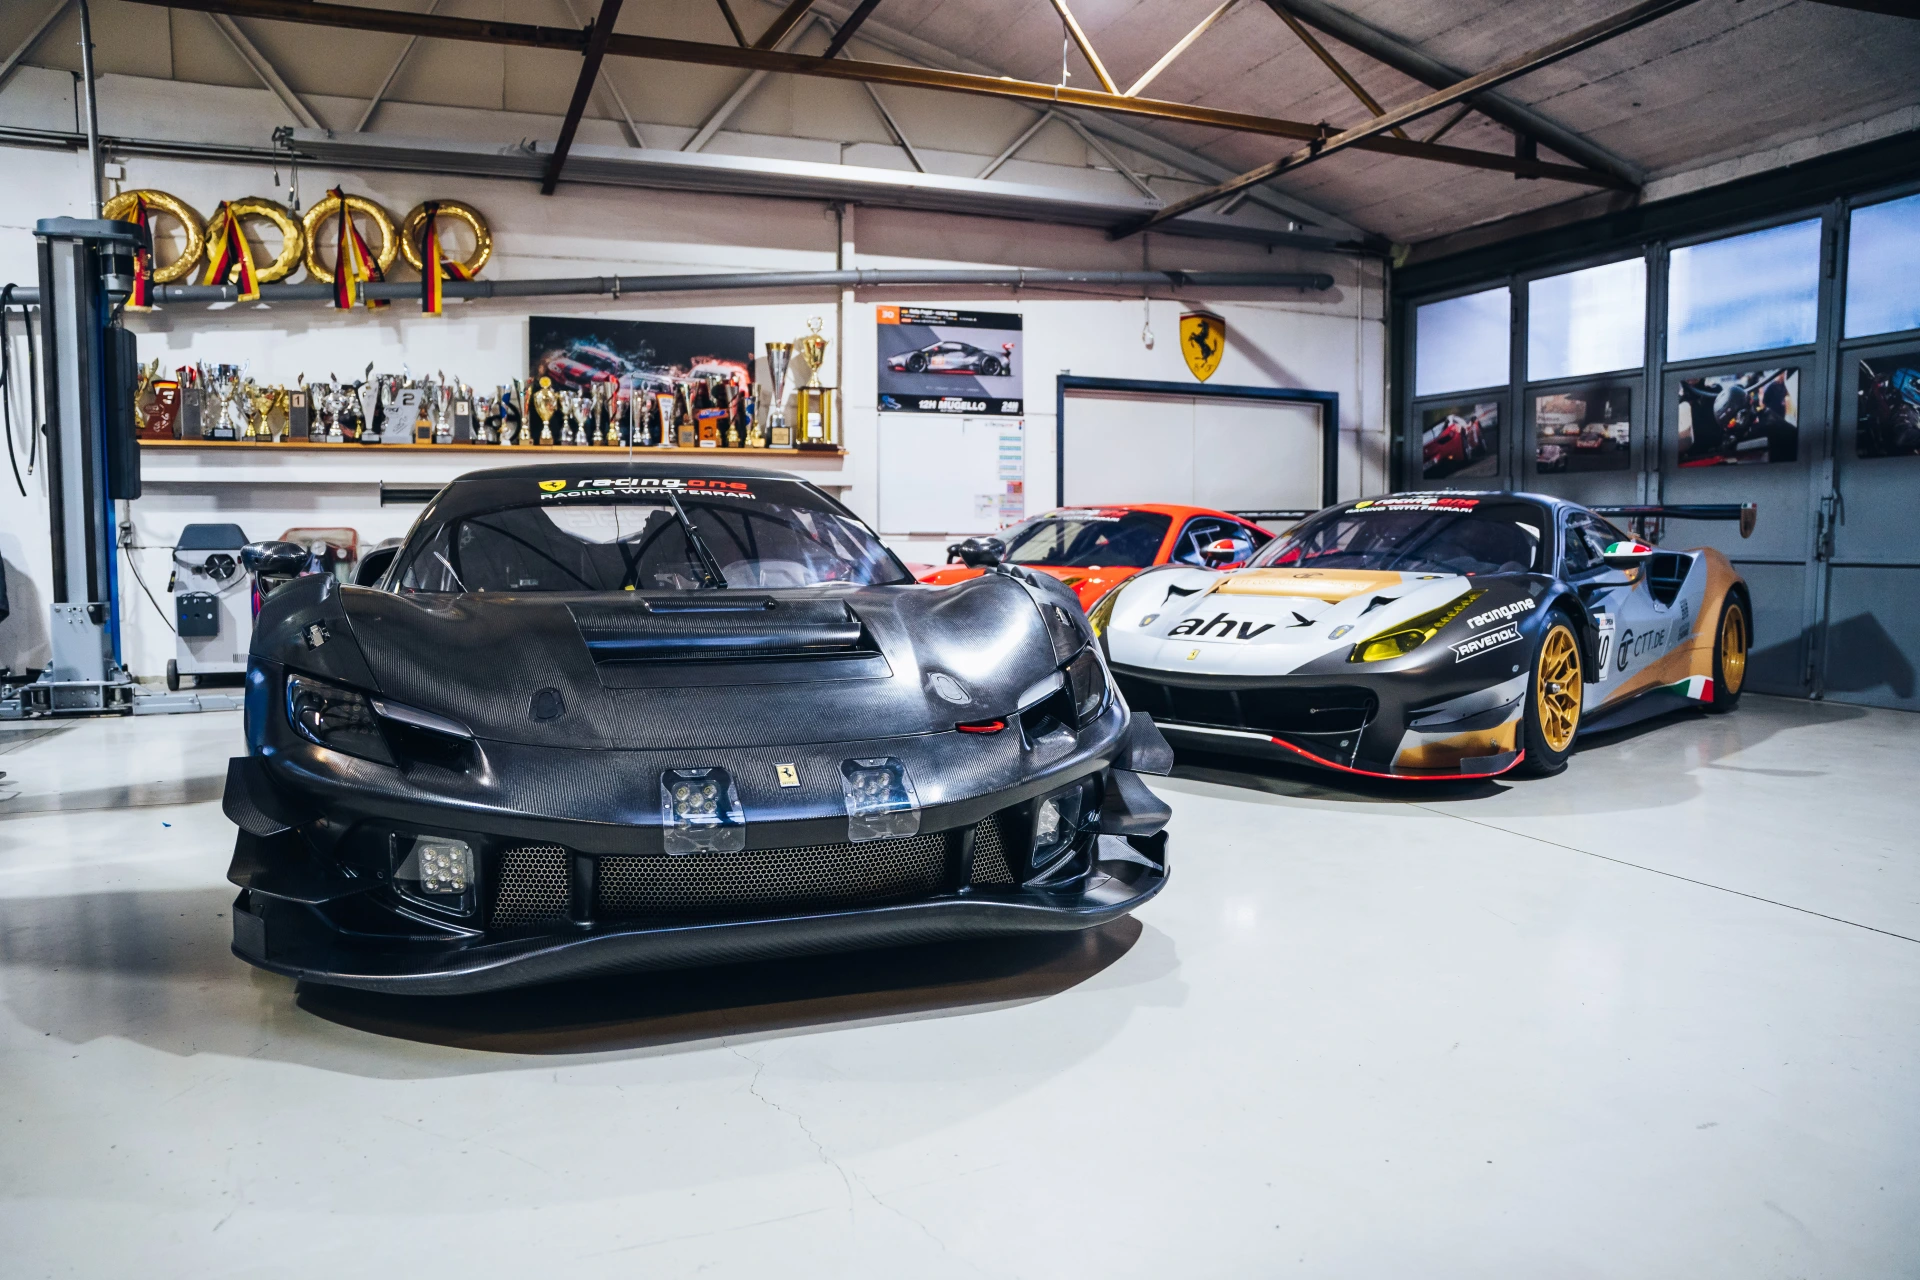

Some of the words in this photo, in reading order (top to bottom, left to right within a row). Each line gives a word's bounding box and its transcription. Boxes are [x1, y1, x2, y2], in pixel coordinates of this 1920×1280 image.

[881, 310, 895, 319] 30
[402, 393, 415, 406] 2
[918, 399, 937, 409] 12H
[938, 400, 987, 411] MUGELLO
[540, 489, 616, 500] RACING
[677, 489, 756, 500] FERRARI
[1168, 612, 1276, 640] ahv
[1458, 628, 1517, 656] RAVENOL
[1633, 628, 1666, 658] CTT.DE
